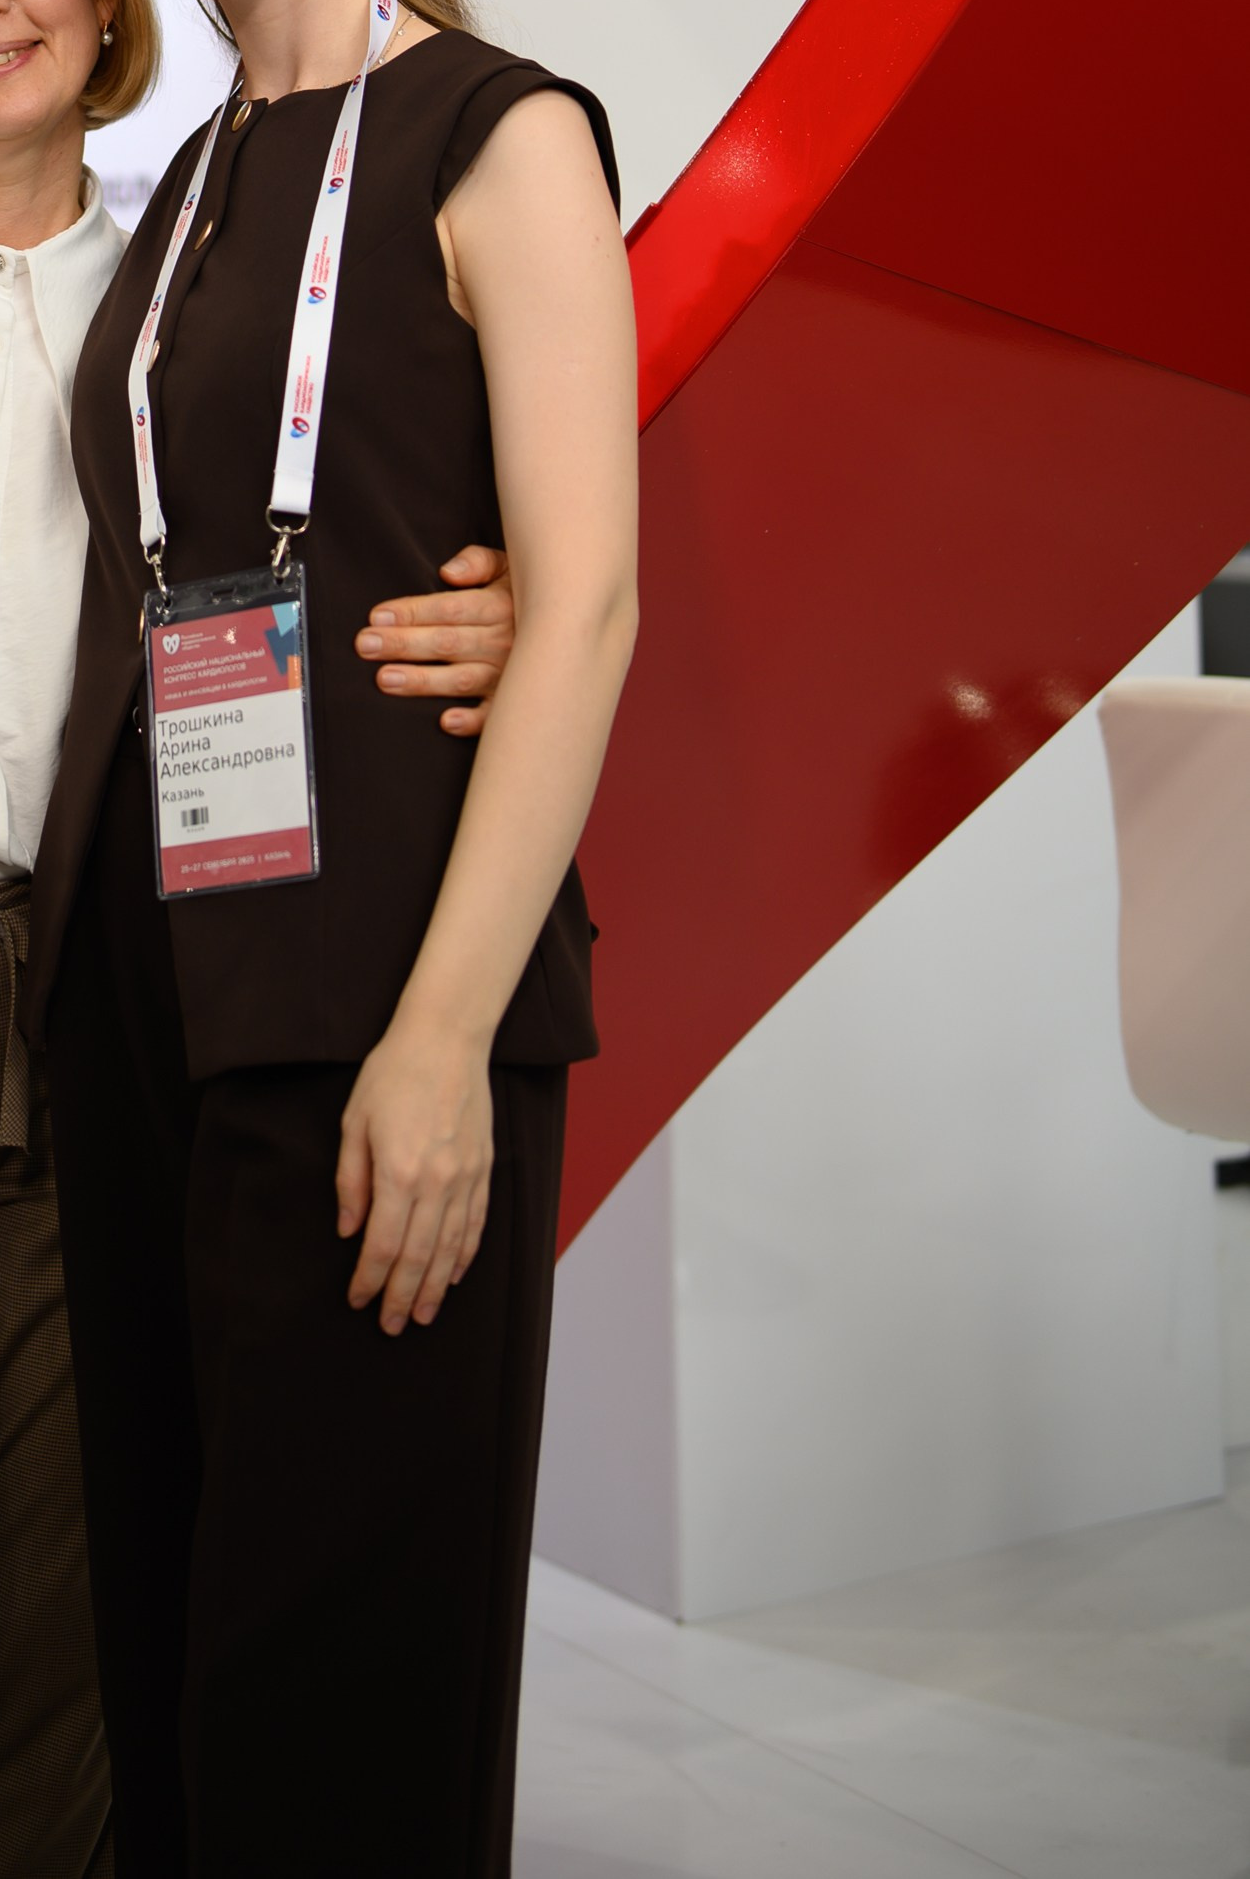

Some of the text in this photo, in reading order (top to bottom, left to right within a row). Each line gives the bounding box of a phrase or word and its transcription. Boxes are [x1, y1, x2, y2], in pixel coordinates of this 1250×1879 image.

[163, 647, 266, 674] РОССИЙСКИЙ НАЦИОНАЛЬНЫЙ
[164, 662, 246, 684] КОНГРЕСС КАРДИОЛОГОВ
[158, 709, 244, 739] Трошкина
[159, 736, 211, 760] Арина
[160, 742, 296, 780] Александровна
[161, 787, 205, 803] Казань
